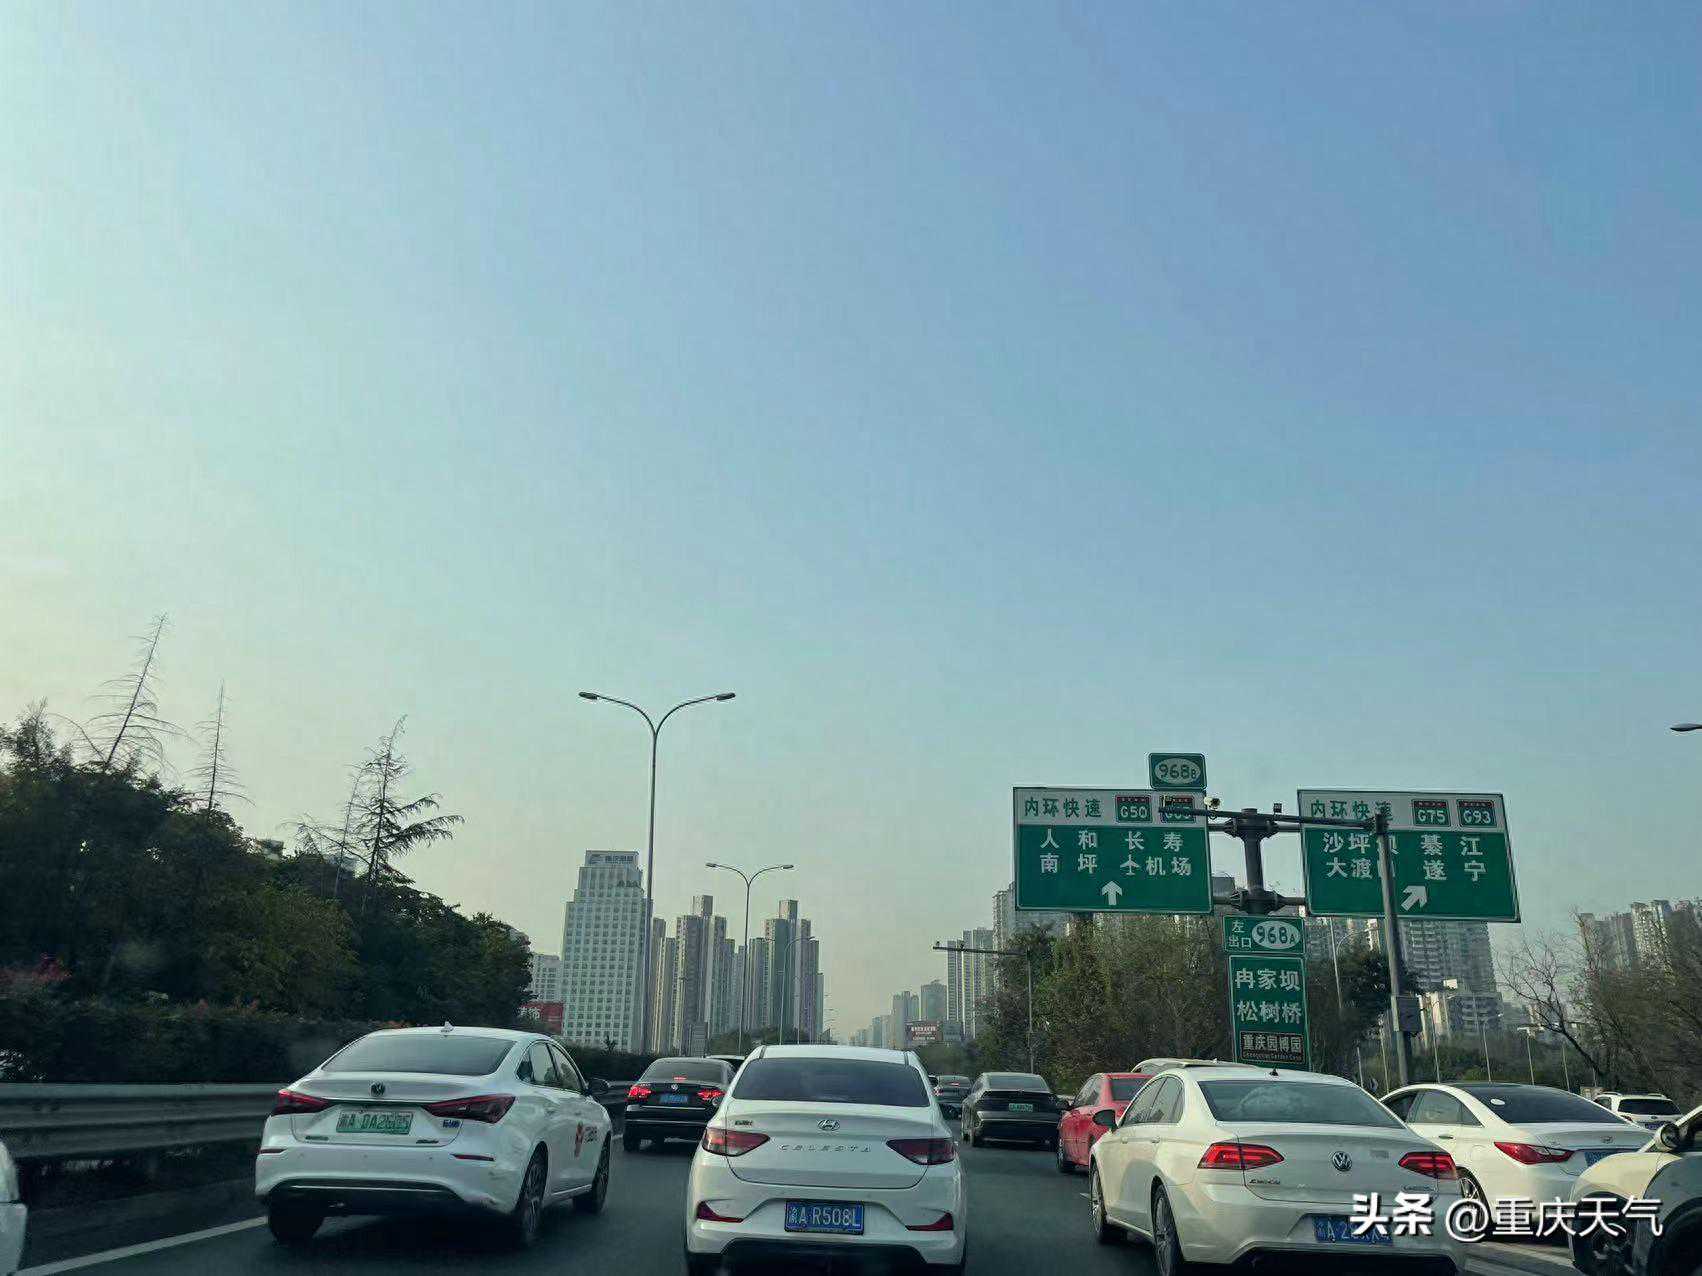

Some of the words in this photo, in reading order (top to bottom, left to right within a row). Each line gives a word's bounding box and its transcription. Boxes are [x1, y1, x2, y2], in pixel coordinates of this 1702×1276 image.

[1024, 797, 1102, 818] 内环快速
[1120, 805, 1148, 818] G50
[1417, 809, 1446, 823] G75
[1463, 810, 1492, 824] G93
[1040, 828, 1098, 850] 人和
[1125, 831, 1184, 852] 长寿
[1420, 834, 1483, 856] 綦江
[1040, 853, 1098, 874] 南坪
[1146, 856, 1192, 877] 机场
[1423, 860, 1488, 882] 遂宁
[1232, 920, 1245, 933] 左
[1256, 925, 1296, 945] 968A
[1228, 936, 1252, 949] 出口
[1234, 968, 1301, 991] 冉家坝
[1236, 1000, 1302, 1024] 松树桥
